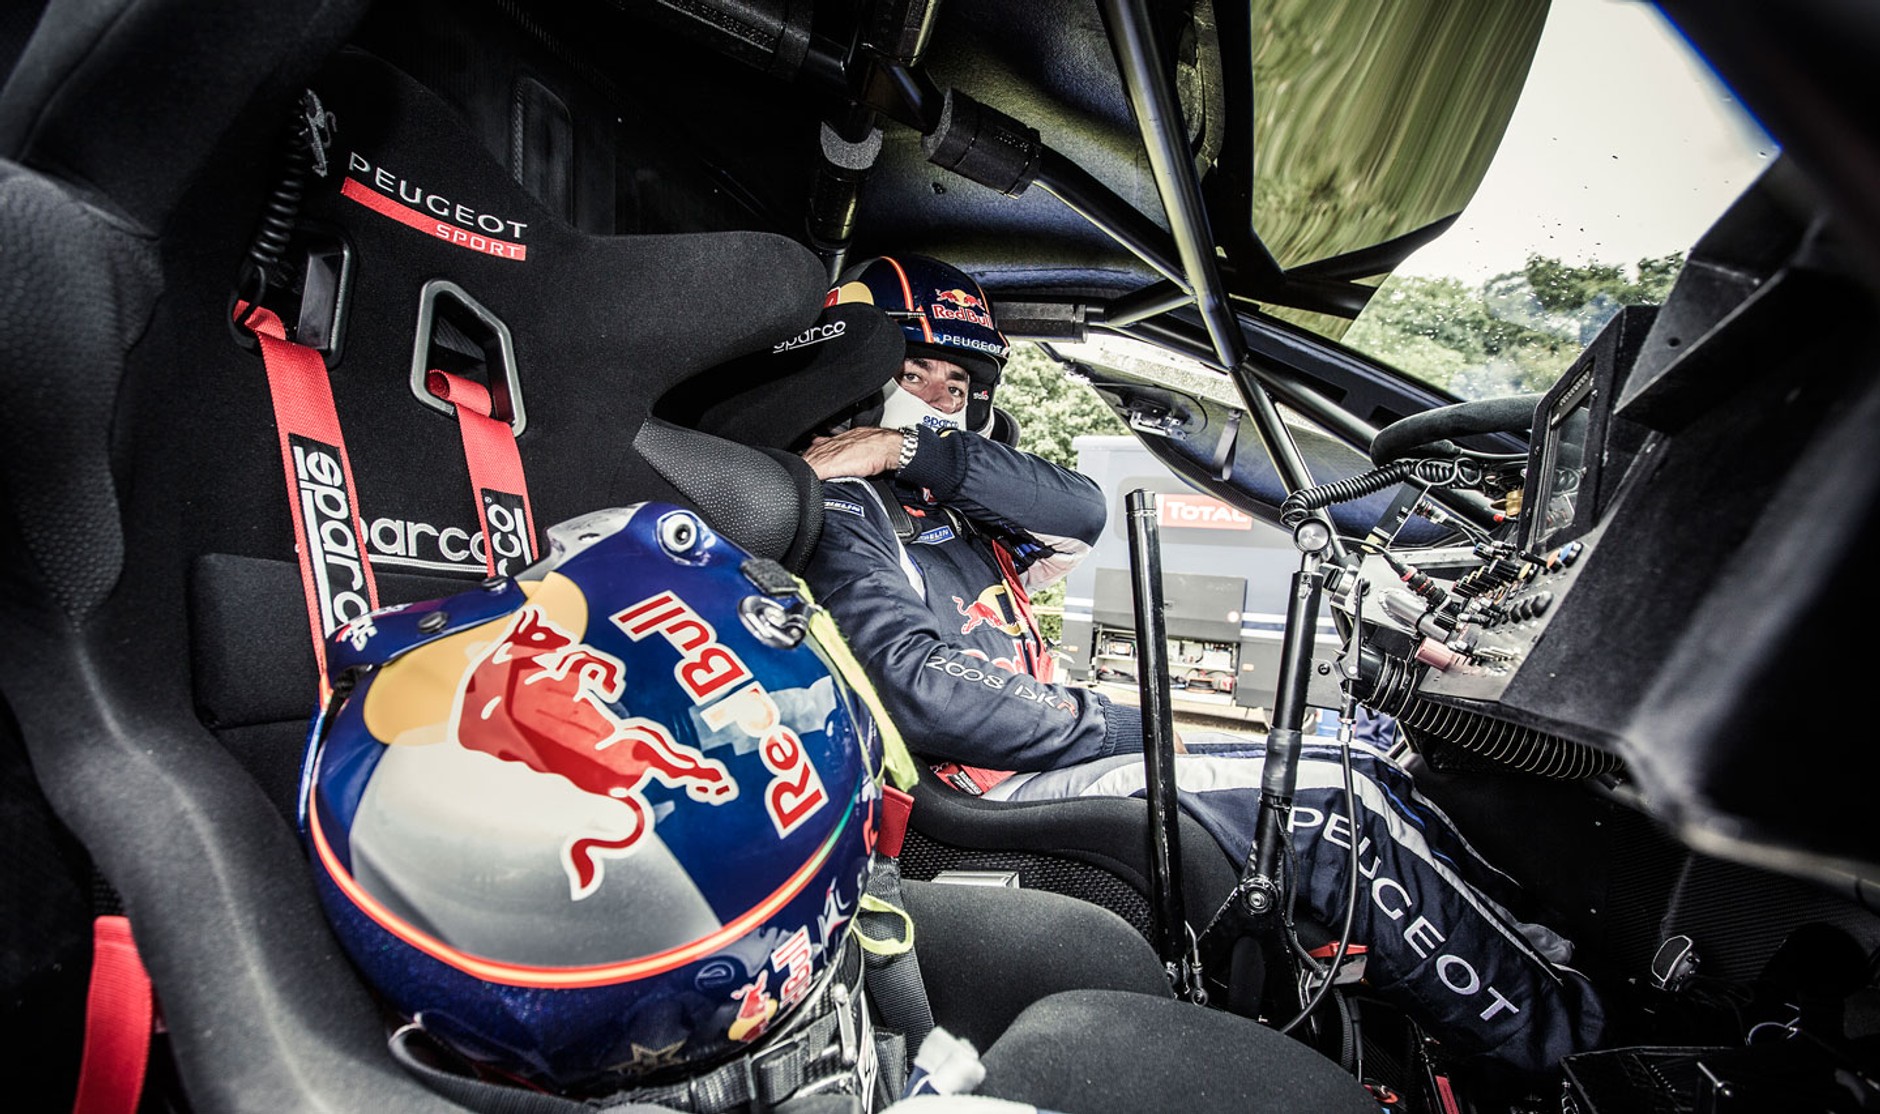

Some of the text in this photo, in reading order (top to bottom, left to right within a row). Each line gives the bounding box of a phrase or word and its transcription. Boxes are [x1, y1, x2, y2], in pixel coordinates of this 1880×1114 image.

[348, 151, 528, 239] PEUGEOT
[435, 223, 521, 258] SPORT
[931, 303, 993, 330] Red Bull
[941, 333, 1003, 355] PEUGEOT
[823, 502, 861, 512] HELIN
[1164, 501, 1251, 523] TOTAL
[298, 449, 371, 628] sparc
[919, 529, 949, 541] HELIN
[925, 655, 1005, 690] 2008
[612, 592, 827, 834] Red Bull
[1287, 806, 1520, 1021] PEUGEOT
